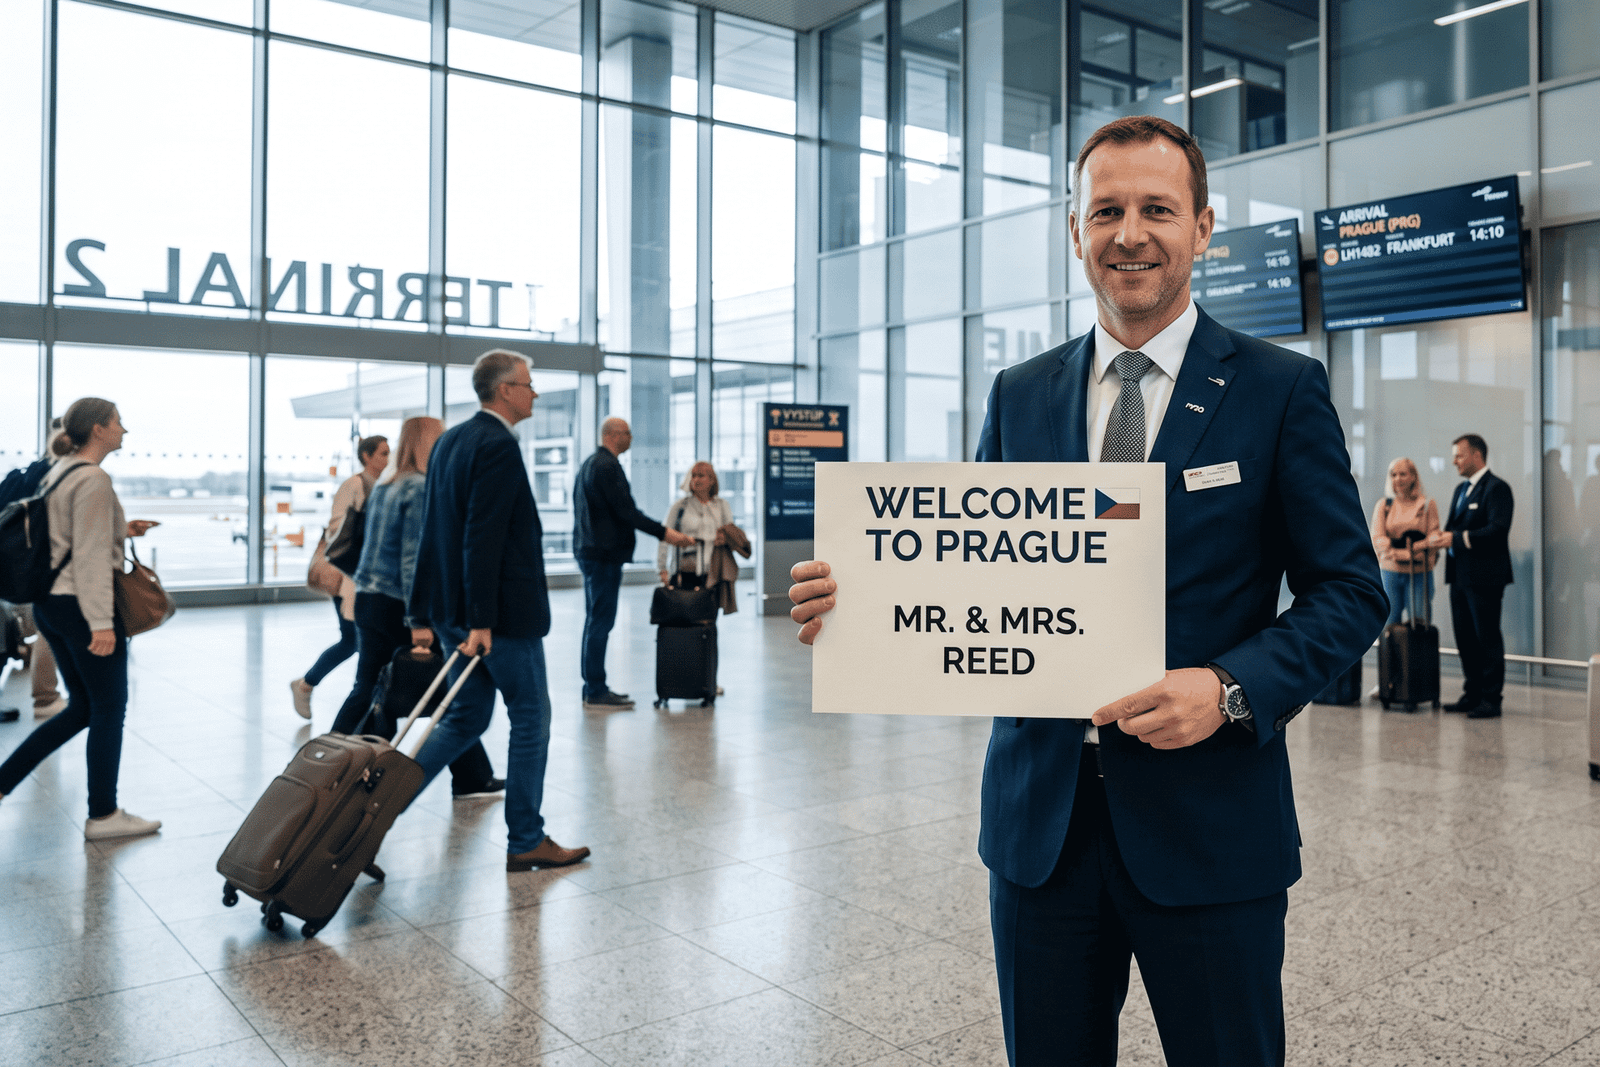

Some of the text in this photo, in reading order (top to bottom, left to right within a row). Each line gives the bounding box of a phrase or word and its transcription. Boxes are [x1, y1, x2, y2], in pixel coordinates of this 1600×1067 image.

[1339, 204, 1389, 224] ARRIVAL
[1339, 213, 1421, 239] PRAGUE (PRG)
[1386, 231, 1456, 255] FRANKFURT
[1469, 224, 1505, 242] 14:10
[865, 486, 1086, 520] WELCOME
[865, 529, 1107, 564] TO PRAGUE
[894, 604, 1085, 635] MR. & MRS.
[943, 646, 1035, 675] REED
